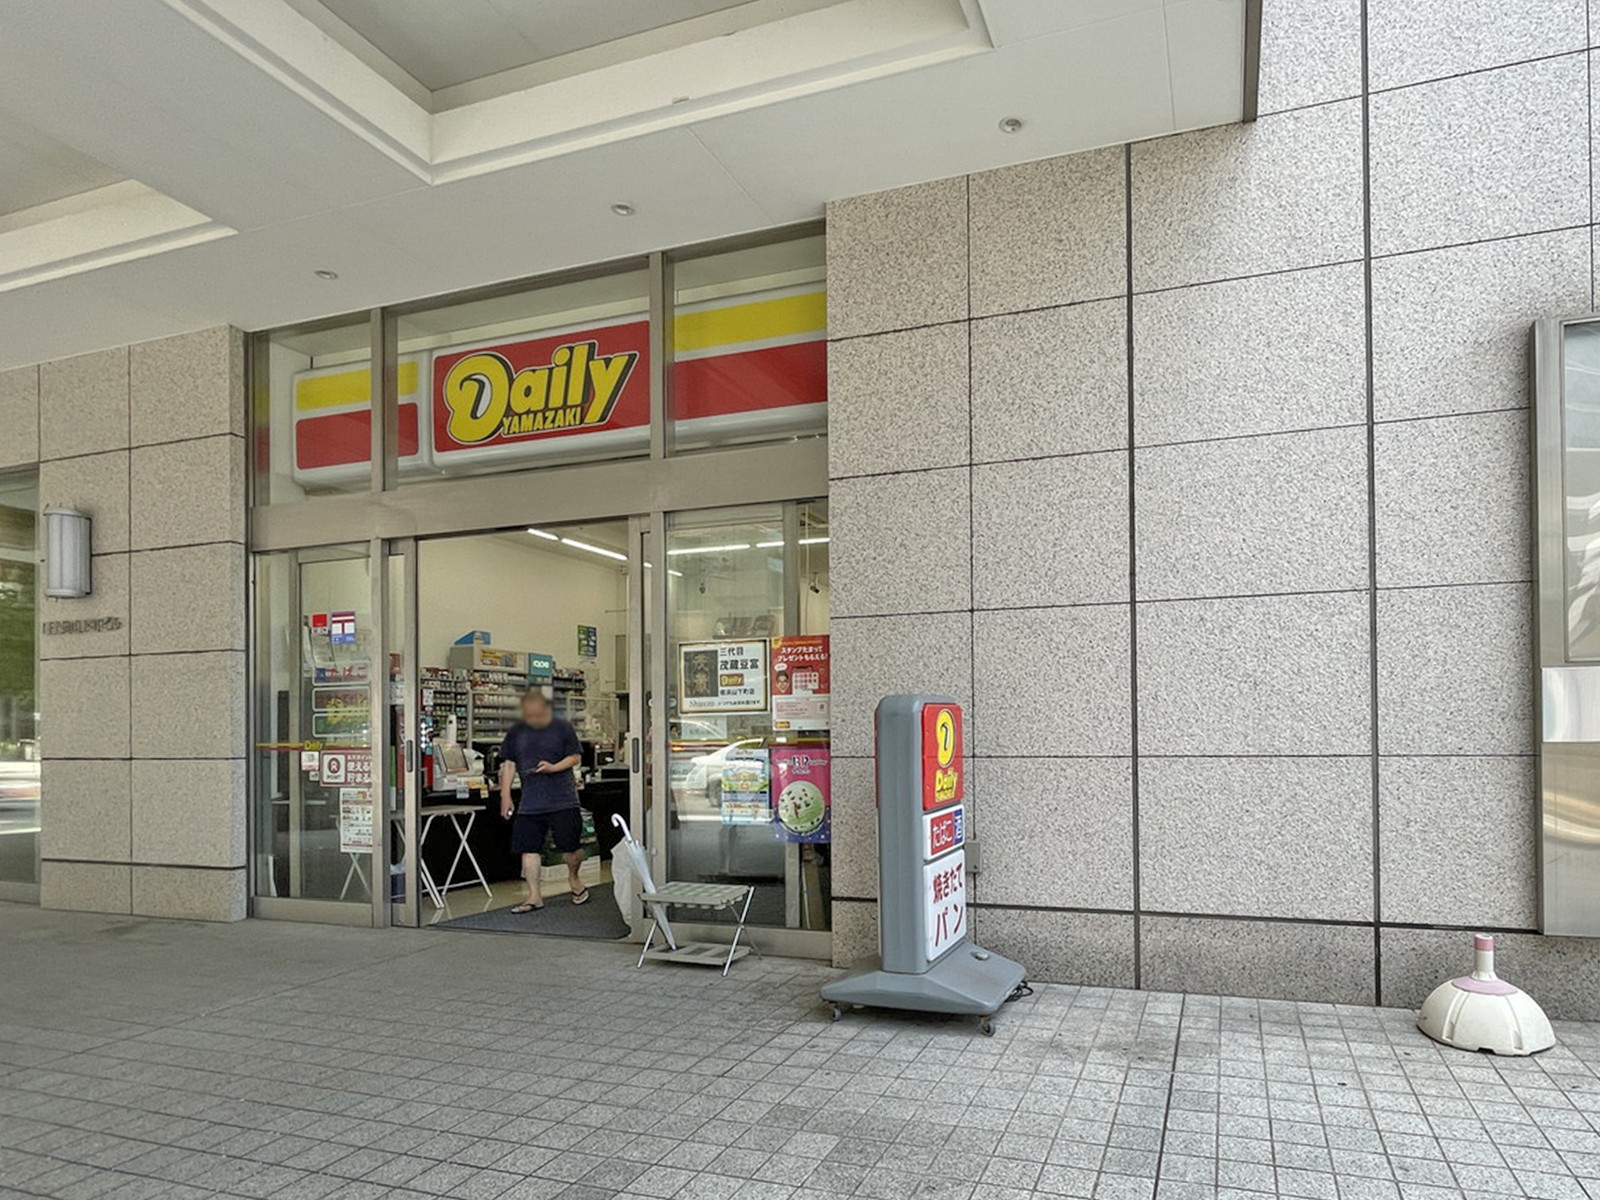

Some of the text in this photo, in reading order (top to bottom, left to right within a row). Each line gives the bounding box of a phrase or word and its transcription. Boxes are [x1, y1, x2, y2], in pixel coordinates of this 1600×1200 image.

[444, 340, 639, 444] Daily
[502, 405, 584, 435] YAMAZAKI
[720, 646, 744, 657] 三代目
[933, 820, 953, 848] たばこ
[933, 862, 963, 903] 焼きたて
[935, 903, 964, 946] パン
